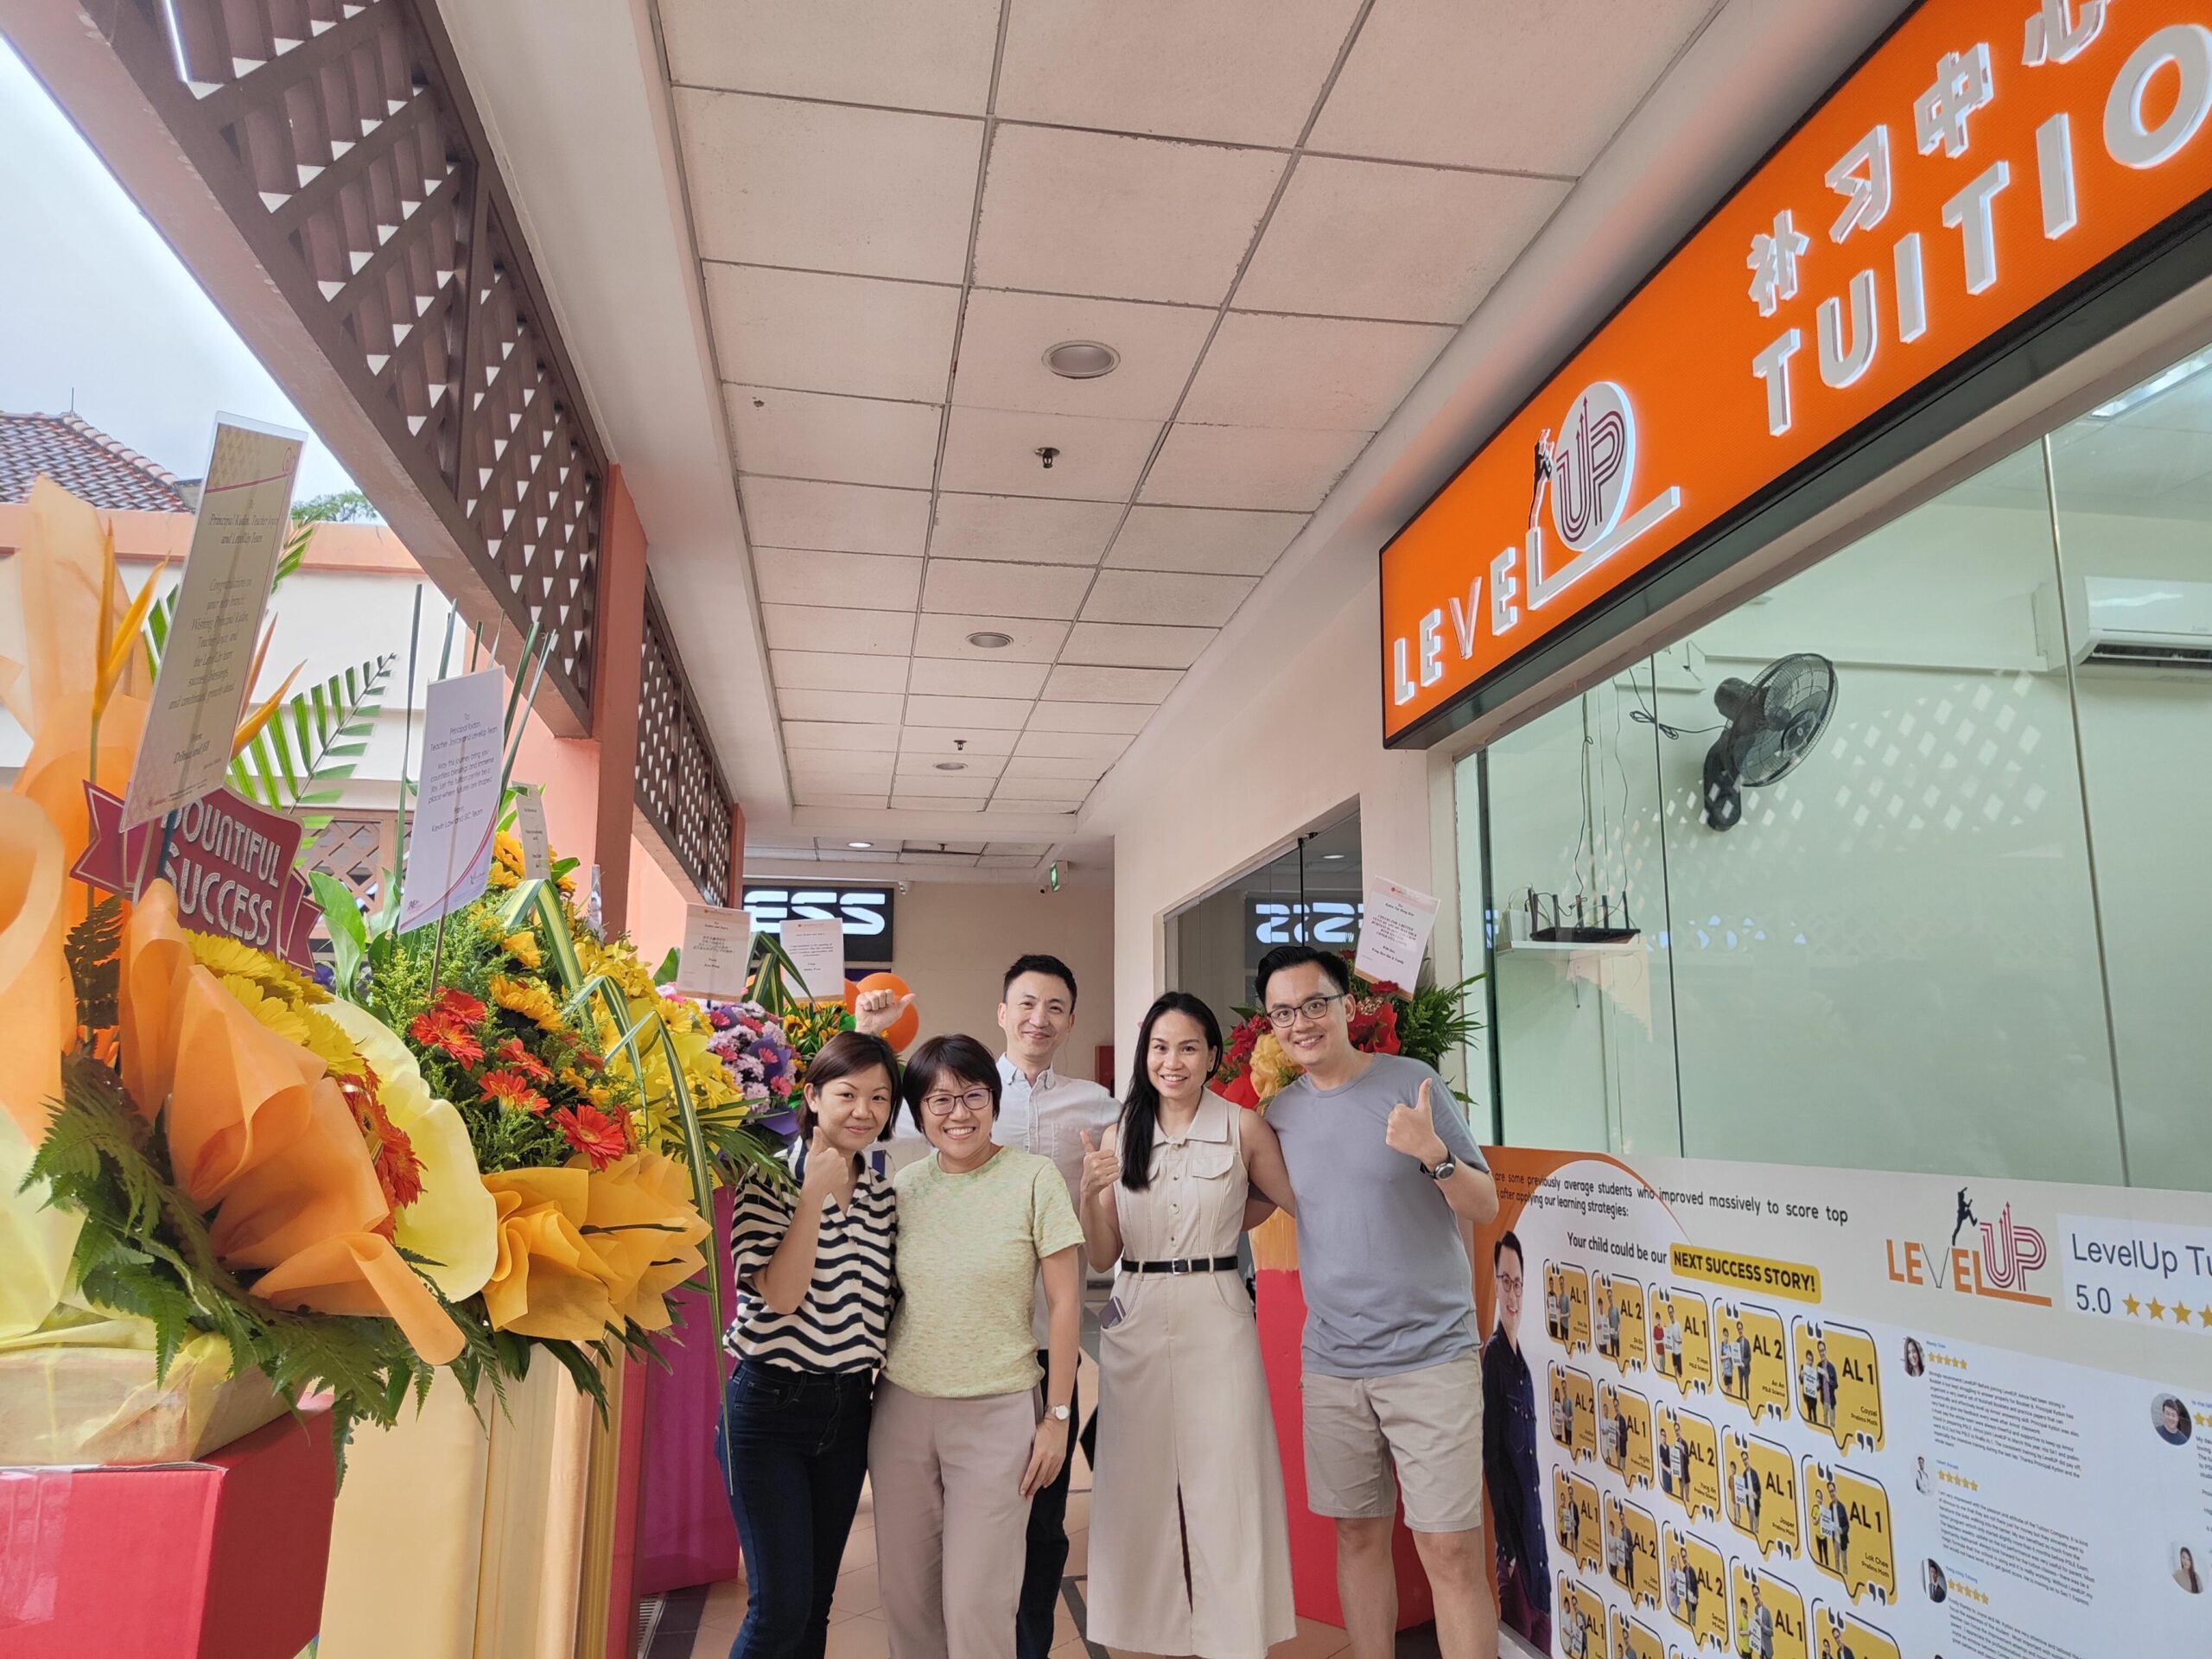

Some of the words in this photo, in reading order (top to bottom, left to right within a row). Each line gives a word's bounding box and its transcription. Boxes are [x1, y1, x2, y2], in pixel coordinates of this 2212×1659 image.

[1556, 396, 1624, 543] UP
[1508, 1174, 1524, 1184] some
[1528, 1175, 1560, 1191] previously
[1564, 1179, 1594, 1197] average
[1598, 1182, 1632, 1198] students
[1637, 1185, 1655, 1199] who
[1659, 1187, 1704, 1205] improved
[1709, 1195, 1761, 1216] massively
[1767, 1199, 1779, 1214] to
[1786, 1204, 1819, 1219] score
[1826, 1205, 1848, 1226] top
[1516, 1192, 1543, 1209] applying
[1545, 1197, 1555, 1206] our
[1557, 1197, 1586, 1216] learning
[1587, 1201, 1629, 1220] strategies:
[1567, 1231, 1586, 1249] Your
[1588, 1236, 1608, 1253] child
[1611, 1239, 1634, 1258] could
[1637, 1243, 1649, 1260] be
[1651, 1250, 1667, 1265] our
[1674, 1251, 1703, 1270] NEXT
[1706, 1257, 1762, 1281] SUCCESS
[1765, 1268, 1815, 1292] STORY!
[1886, 1239, 2052, 1306] LEVEL
[1980, 1201, 2046, 1291] UP
[2072, 1233, 2177, 1279] LevelUp
[1570, 1286, 1581, 1304] AL
[1583, 1290, 1586, 1306] 1
[1620, 1299, 1633, 1317] AL
[1636, 1303, 1642, 1319] 2
[2076, 1284, 2111, 1314] 5.0
[1684, 1316, 1700, 1336] AL
[1702, 1320, 1707, 1338] 1
[1753, 1334, 1770, 1357] AL
[1774, 1340, 1783, 1360] 2
[1842, 1357, 1863, 1382] AL
[1867, 1364, 1873, 1385] 1
[1627, 1414, 1639, 1435] AL
[1642, 1421, 1646, 1438] 1
[1689, 1440, 1704, 1463] AL
[1707, 1447, 1715, 1467] 2
[1766, 1471, 1784, 1496] AL
[1788, 1479, 1793, 1500] 1
[1581, 1499, 1592, 1521] AL
[1594, 1507, 1599, 1523] 1
[1850, 1501, 1872, 1529] AL
[1875, 1511, 1882, 1533] 1
[1634, 1532, 1647, 1554] AL
[1649, 1541, 1656, 1560] 2
[1697, 1567, 1713, 1592] AL
[1716, 1577, 1724, 1598] 2
[1586, 1614, 1598, 1636] AL
[1601, 1624, 1604, 1640] 1
[1775, 1609, 1794, 1637] AL
[1797, 1621, 1802, 1642] 1
